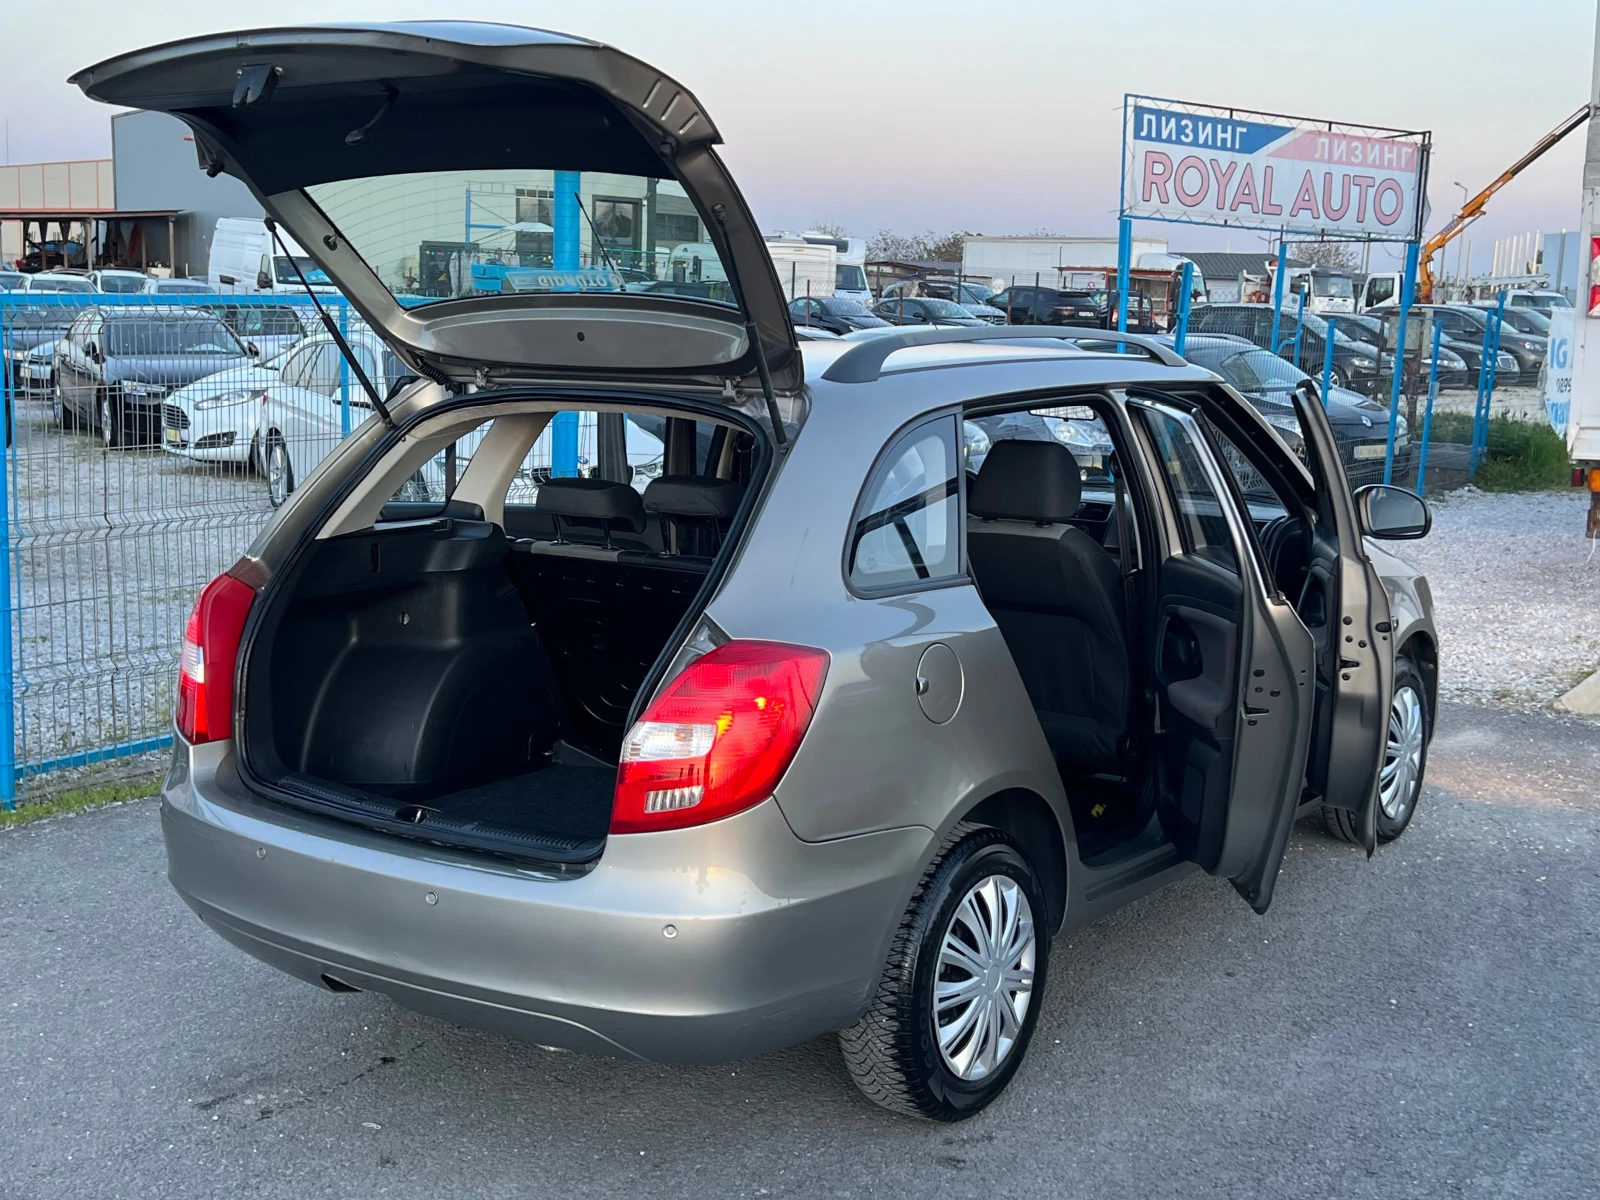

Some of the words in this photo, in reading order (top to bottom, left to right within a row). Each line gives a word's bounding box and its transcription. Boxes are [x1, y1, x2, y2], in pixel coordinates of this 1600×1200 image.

[1140, 113, 1247, 149] ЛИЗИНГ
[1314, 137, 1412, 168] ЛИЗИНГ
[1142, 150, 1283, 216] ROYAL
[1289, 169, 1404, 226] AUTO
